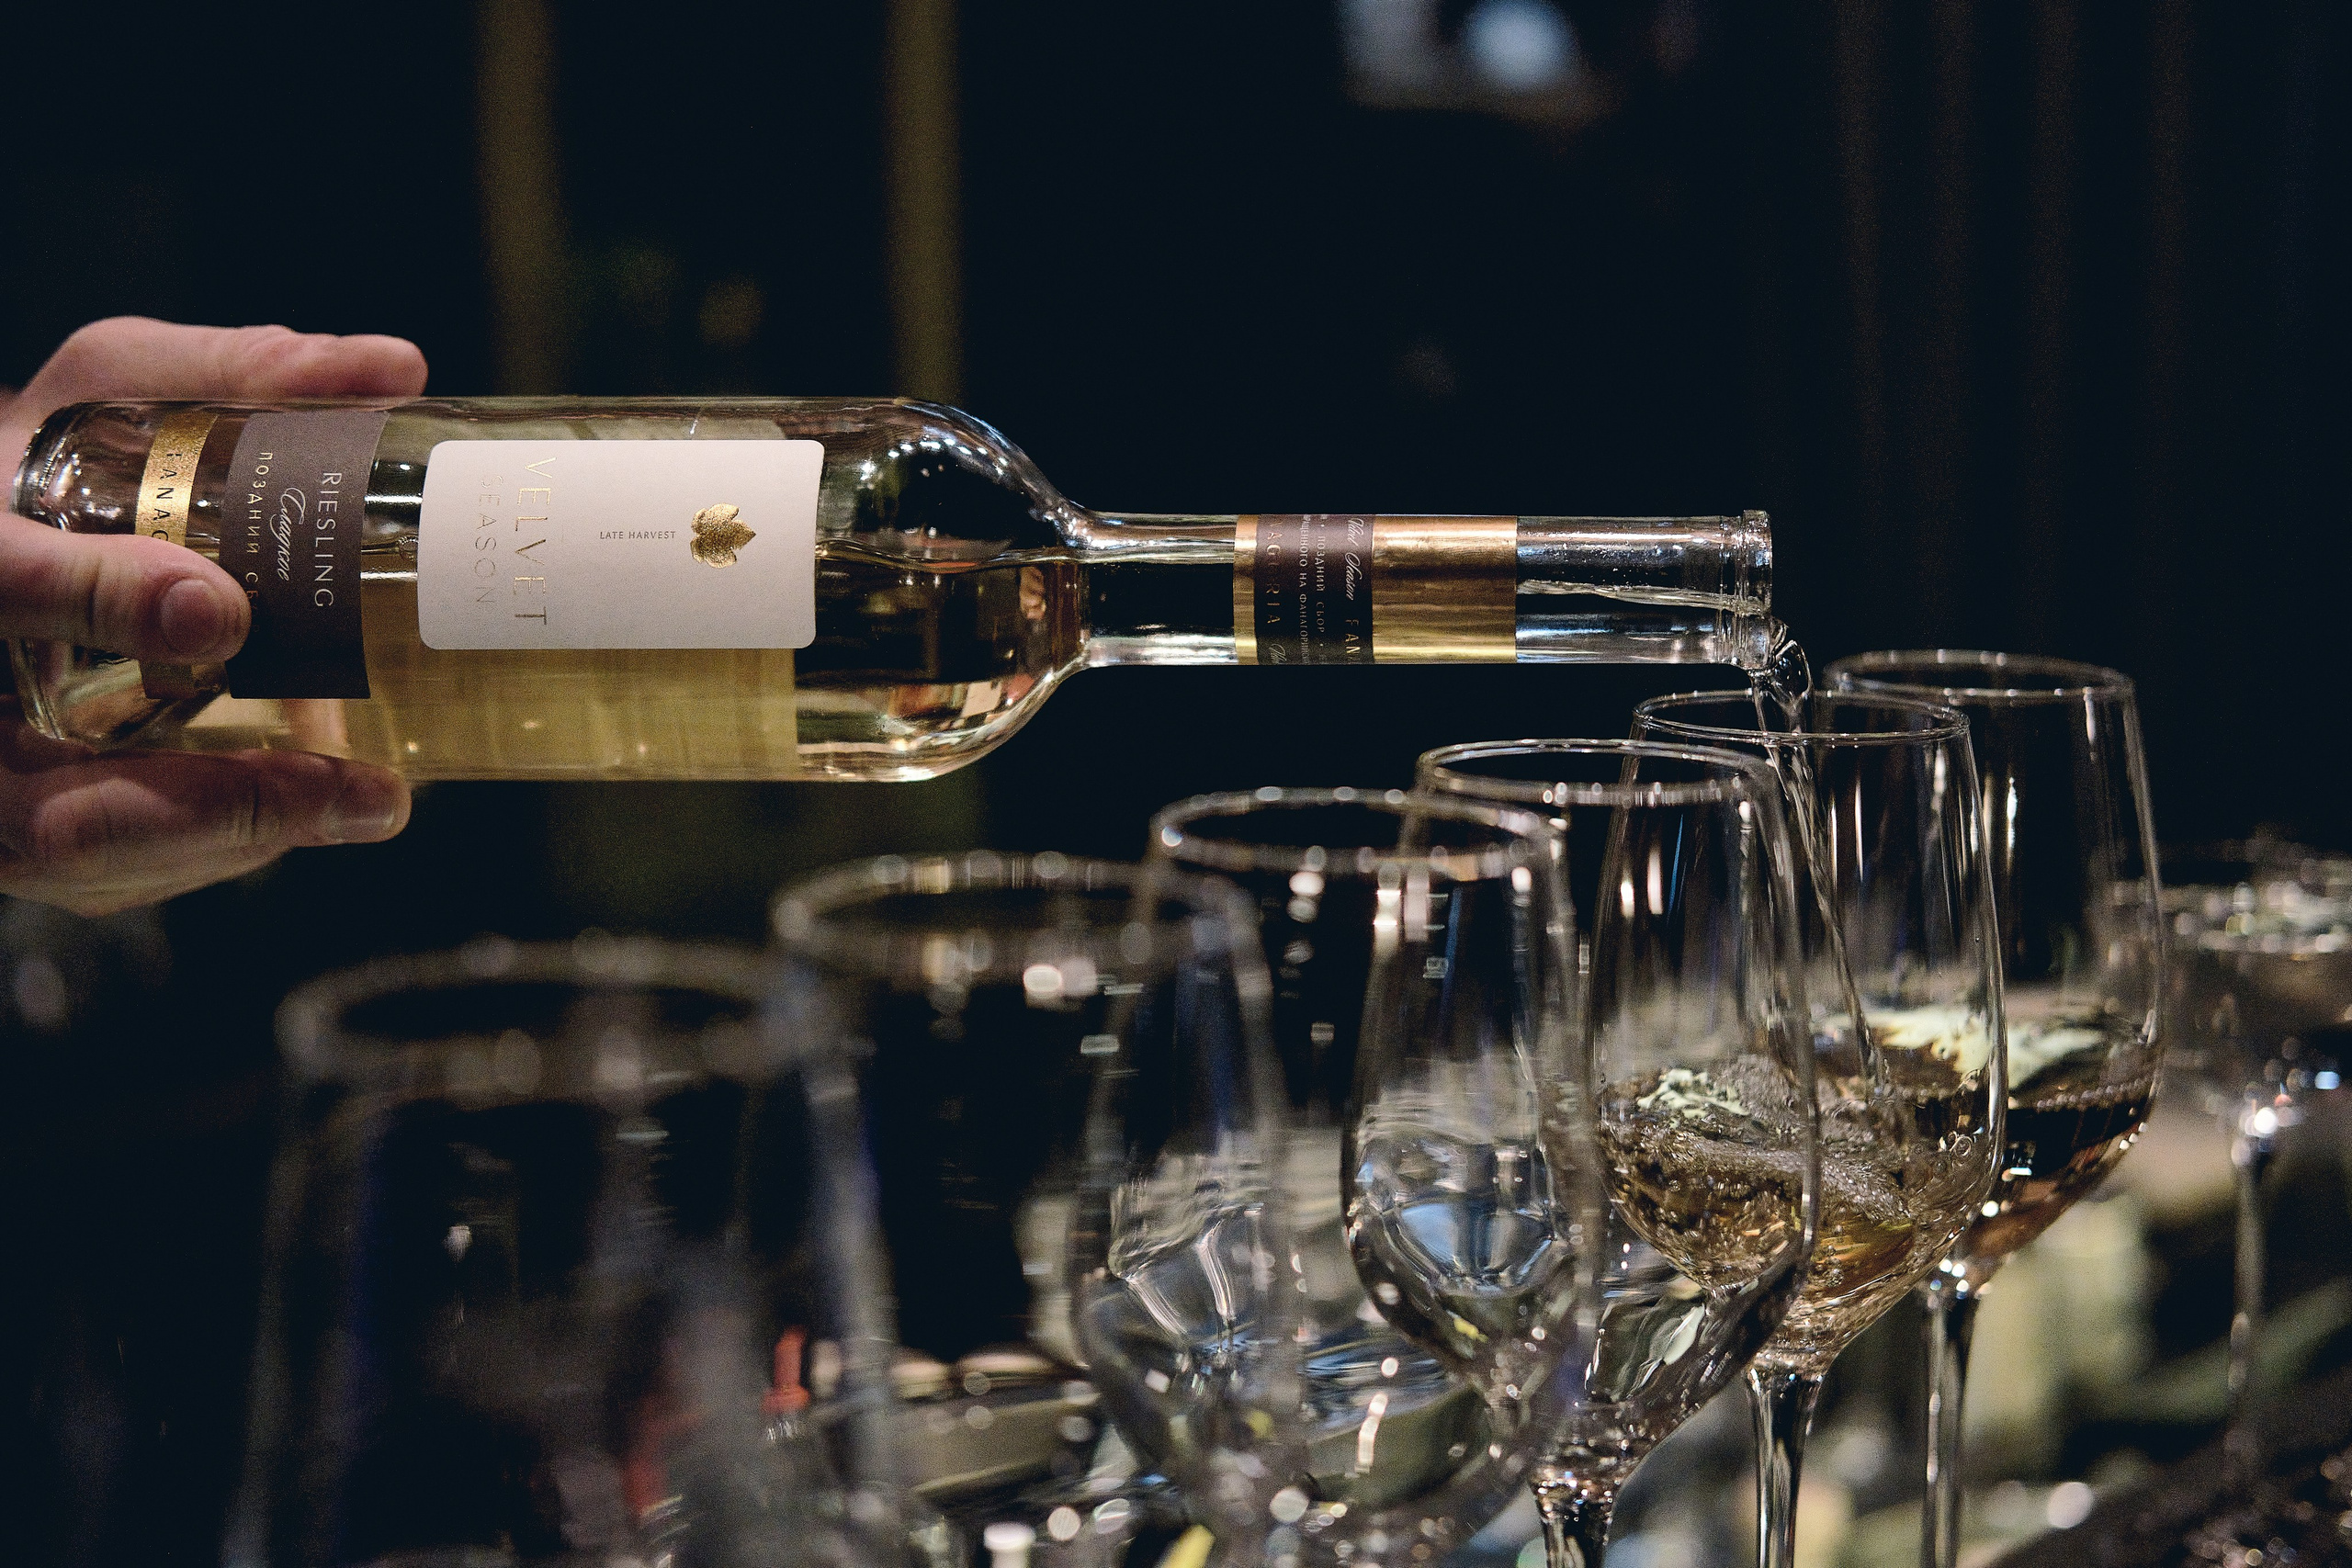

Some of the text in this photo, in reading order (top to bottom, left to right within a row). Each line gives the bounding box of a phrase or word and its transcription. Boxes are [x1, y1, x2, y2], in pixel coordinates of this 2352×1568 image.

[246, 452, 273, 553] ПОЗДНИЙ
[270, 487, 306, 581] Сладкое
[314, 472, 342, 607] RIESLING
[474, 475, 503, 605] SEASON
[514, 457, 556, 626] VELVET
[599, 530, 676, 540] LATE HARVEST
[1298, 572, 1307, 588] НА
[1315, 536, 1327, 592] ПОЗДНИЙ
[1345, 552, 1363, 600] Season
